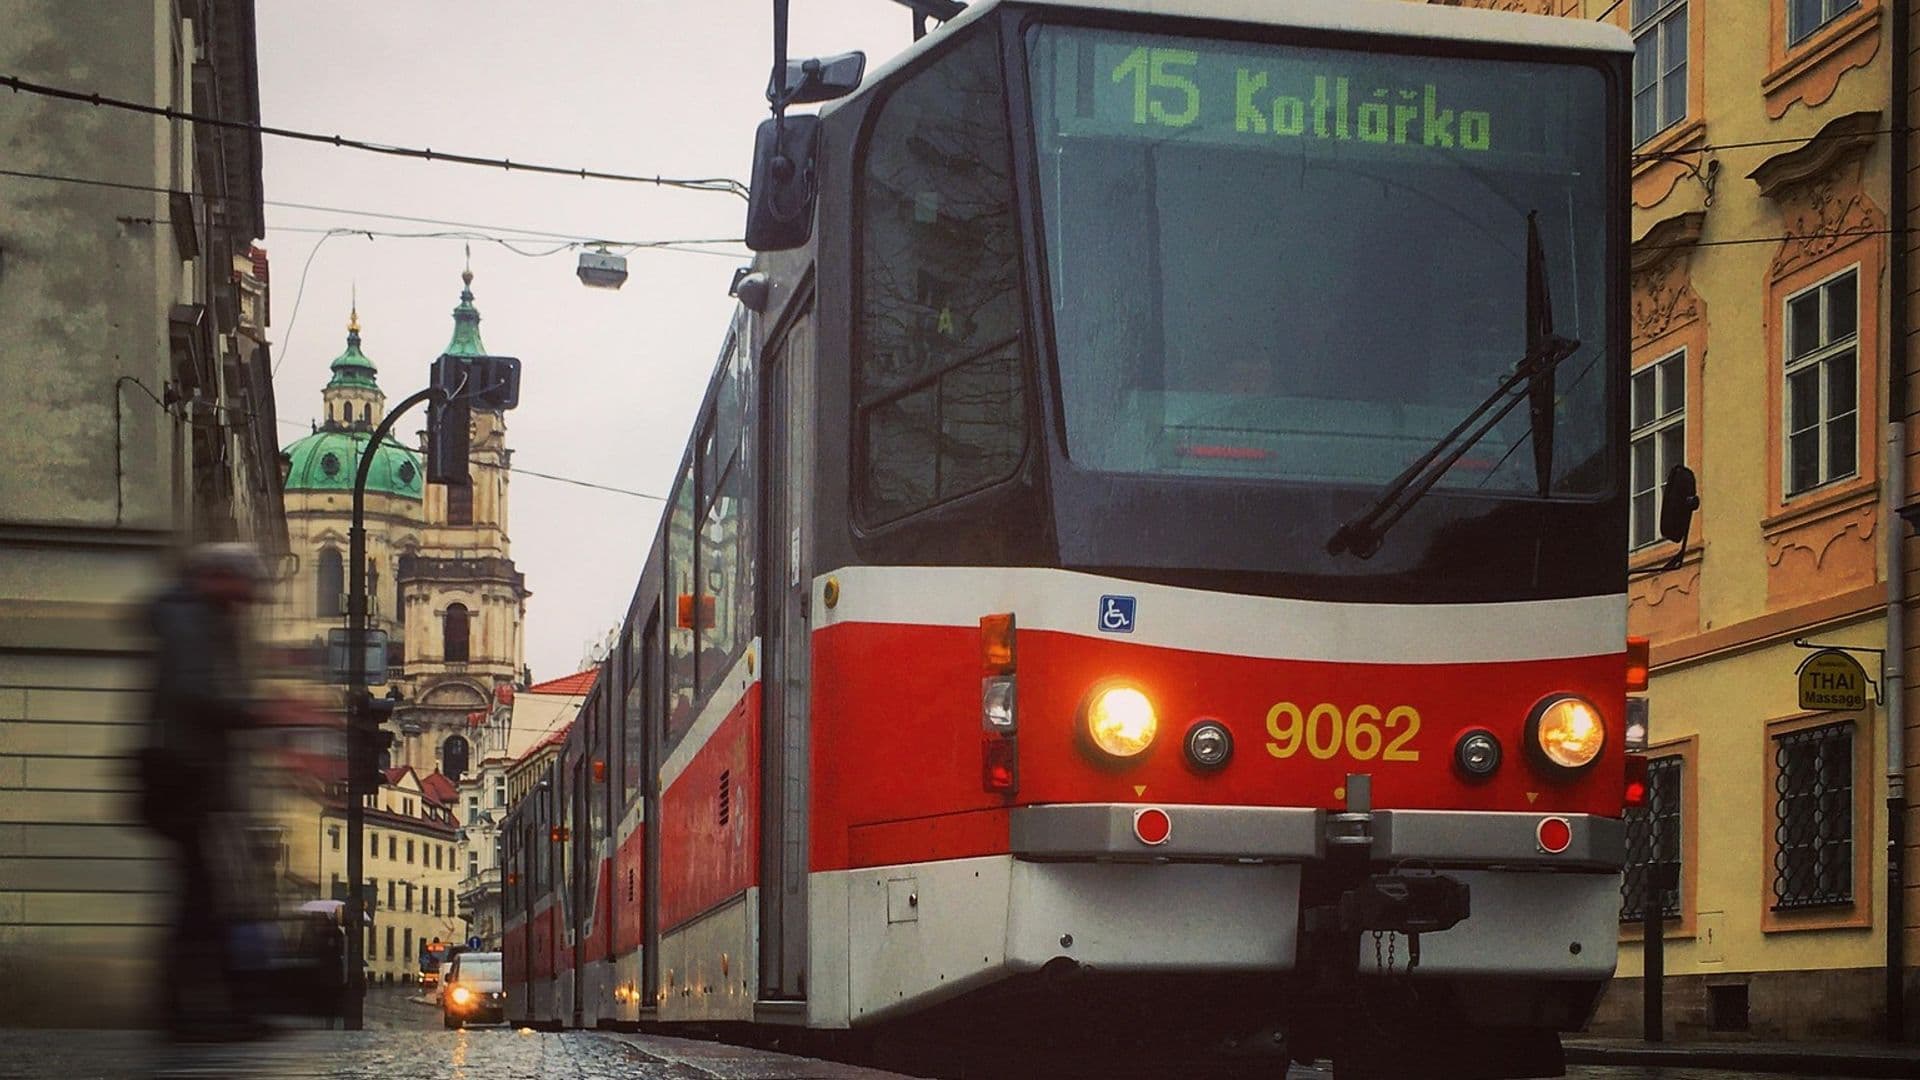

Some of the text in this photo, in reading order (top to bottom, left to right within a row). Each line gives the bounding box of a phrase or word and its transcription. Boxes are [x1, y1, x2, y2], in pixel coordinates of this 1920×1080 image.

[1112, 46, 1491, 150] 15 Kotlářka
[1806, 691, 1860, 706] Massage
[1810, 673, 1854, 689] THAI
[1265, 702, 1421, 761] 9062
